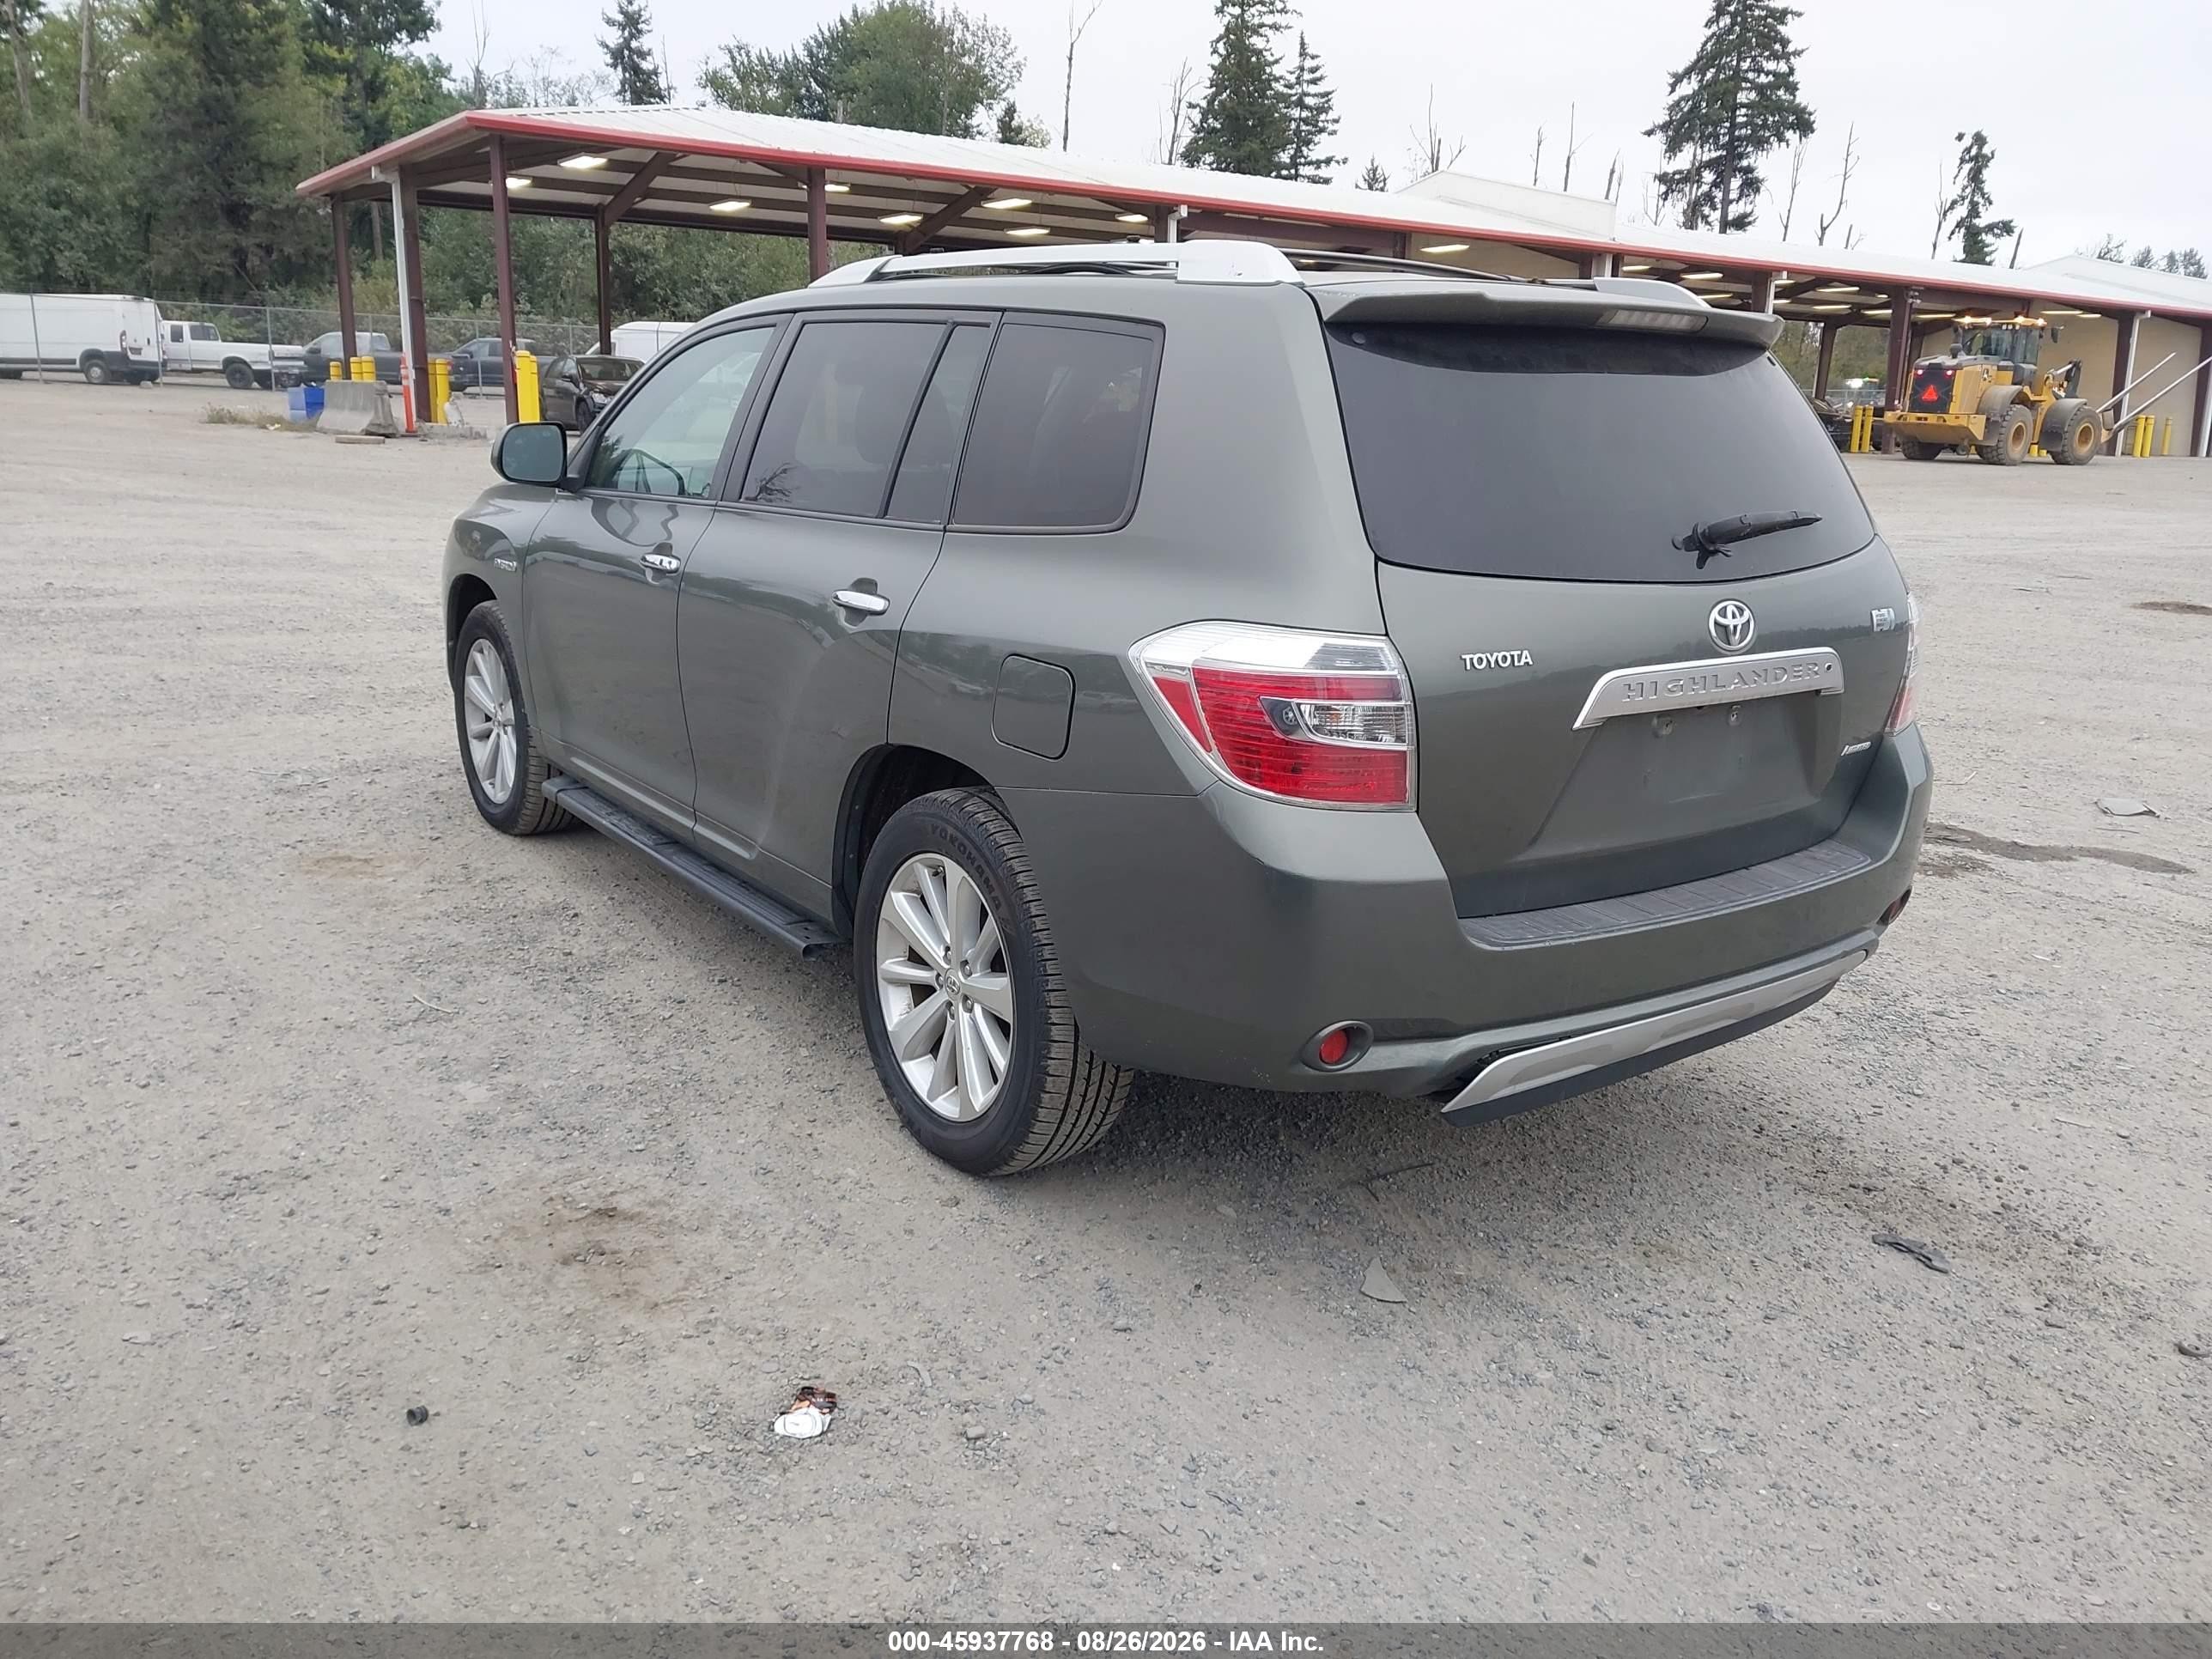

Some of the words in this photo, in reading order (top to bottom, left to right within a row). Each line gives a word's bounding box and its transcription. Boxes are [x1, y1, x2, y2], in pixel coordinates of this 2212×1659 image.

[1461, 647, 1534, 671] TOYOTA
[1621, 661, 1821, 702] HIGHLANDER
[931, 823, 1003, 911] YOKOHAMA
